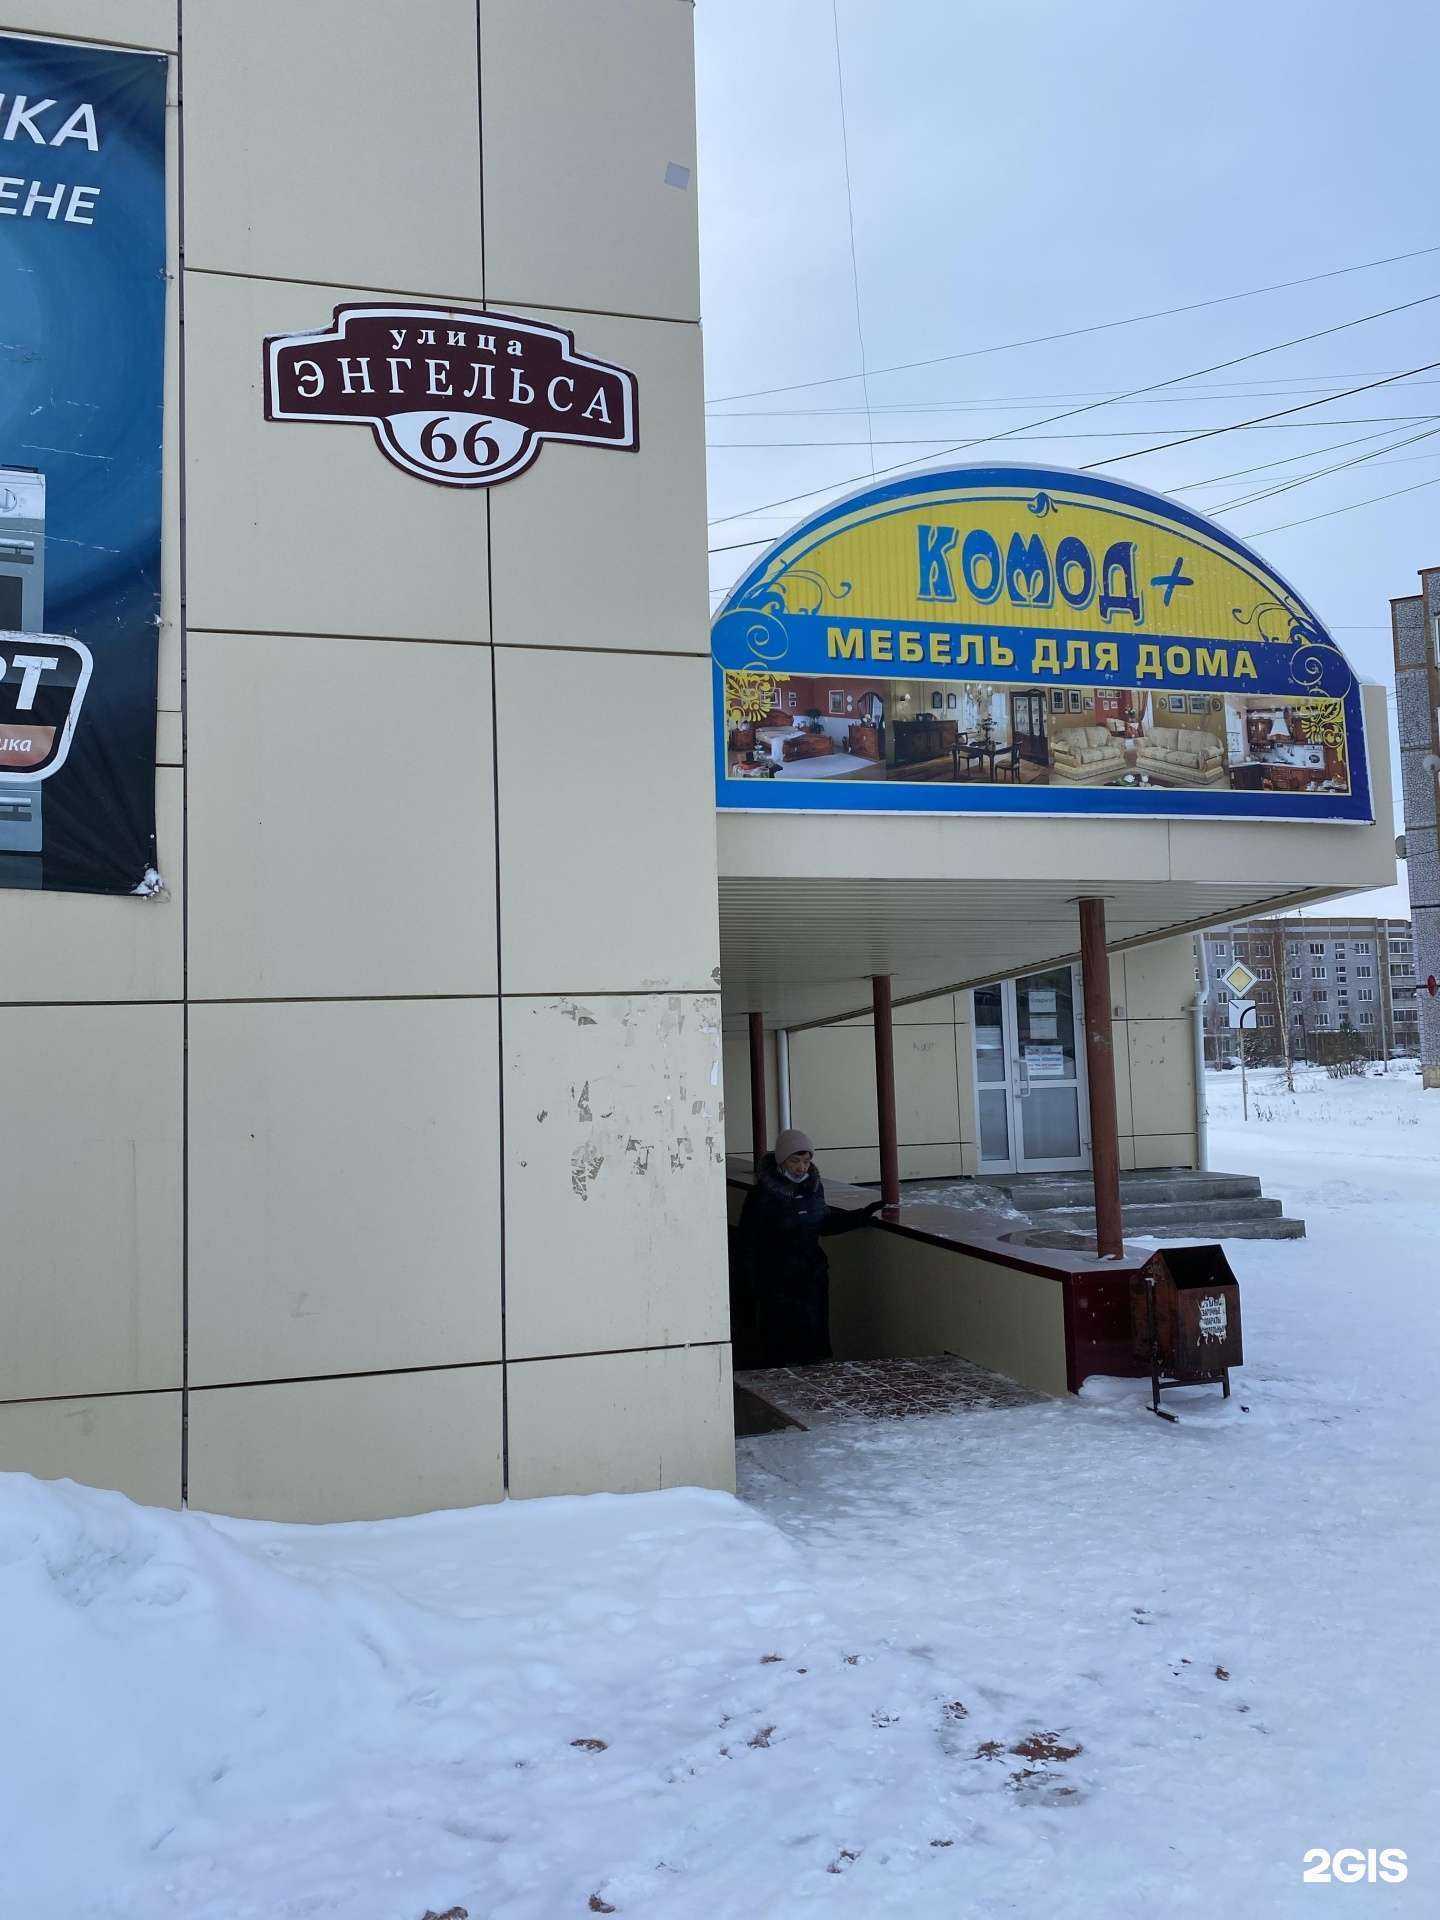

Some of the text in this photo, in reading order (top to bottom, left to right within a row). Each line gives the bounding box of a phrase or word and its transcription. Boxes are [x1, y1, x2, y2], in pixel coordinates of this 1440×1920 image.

[0, 93, 98, 151] КА
[389, 329, 523, 356] улица
[294, 357, 612, 424] ЭНГЕЛЬСА
[420, 416, 500, 466] 66
[827, 627, 1258, 679] МЕБЕЛЬ ДЛЯ ДОМА
